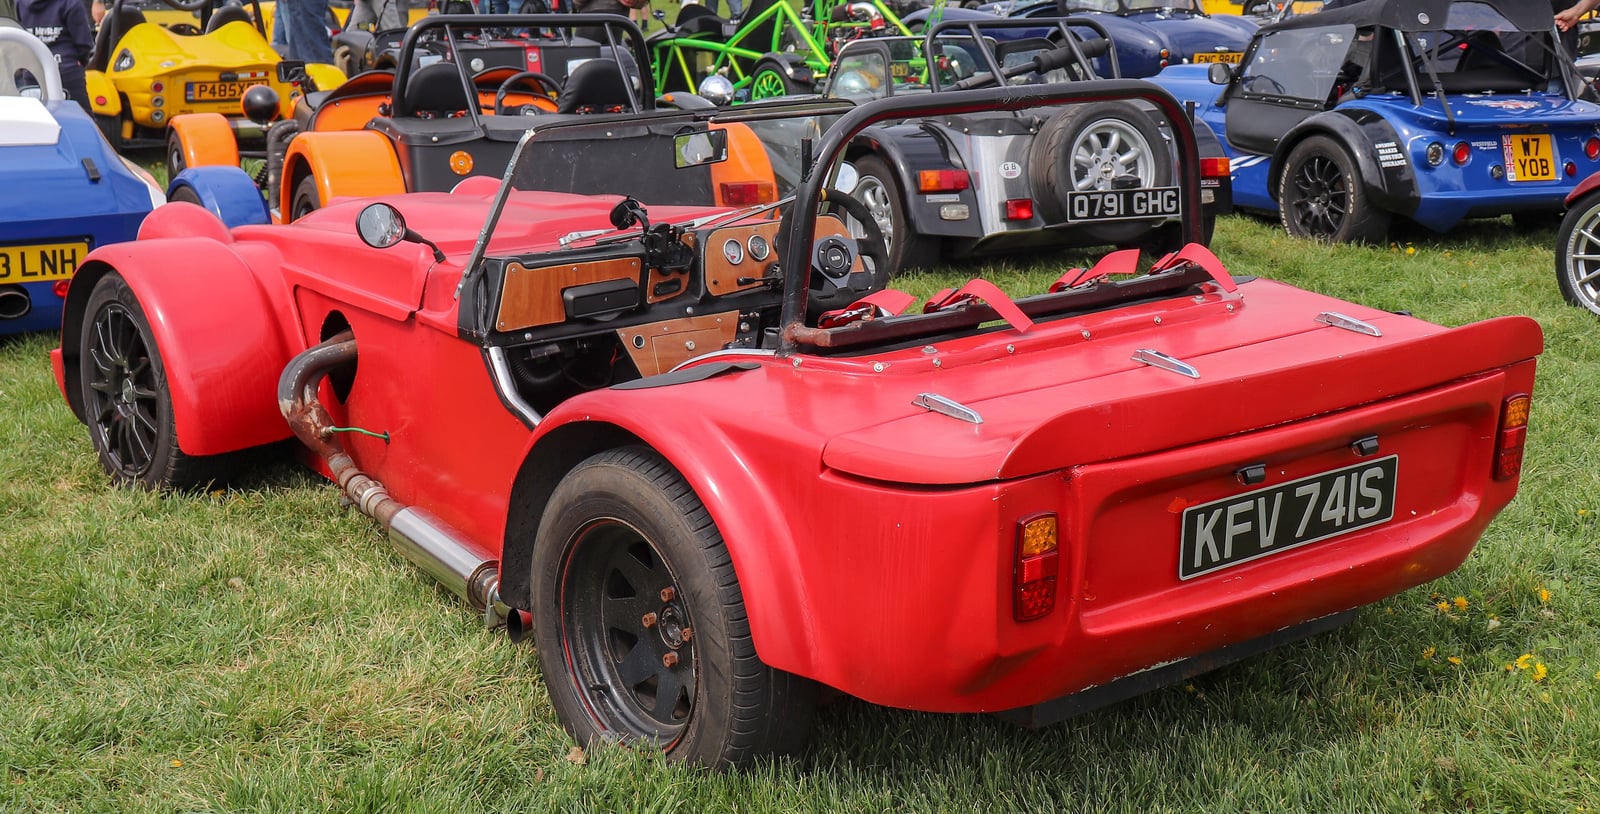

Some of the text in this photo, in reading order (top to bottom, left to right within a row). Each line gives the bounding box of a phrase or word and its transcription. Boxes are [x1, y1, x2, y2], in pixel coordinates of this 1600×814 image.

[1521, 138, 1540, 156] W7
[1519, 158, 1550, 177] YOB
[1073, 190, 1177, 218] Q791 GHG
[20, 248, 77, 278] LNH
[1193, 465, 1385, 568] KFV 741S
